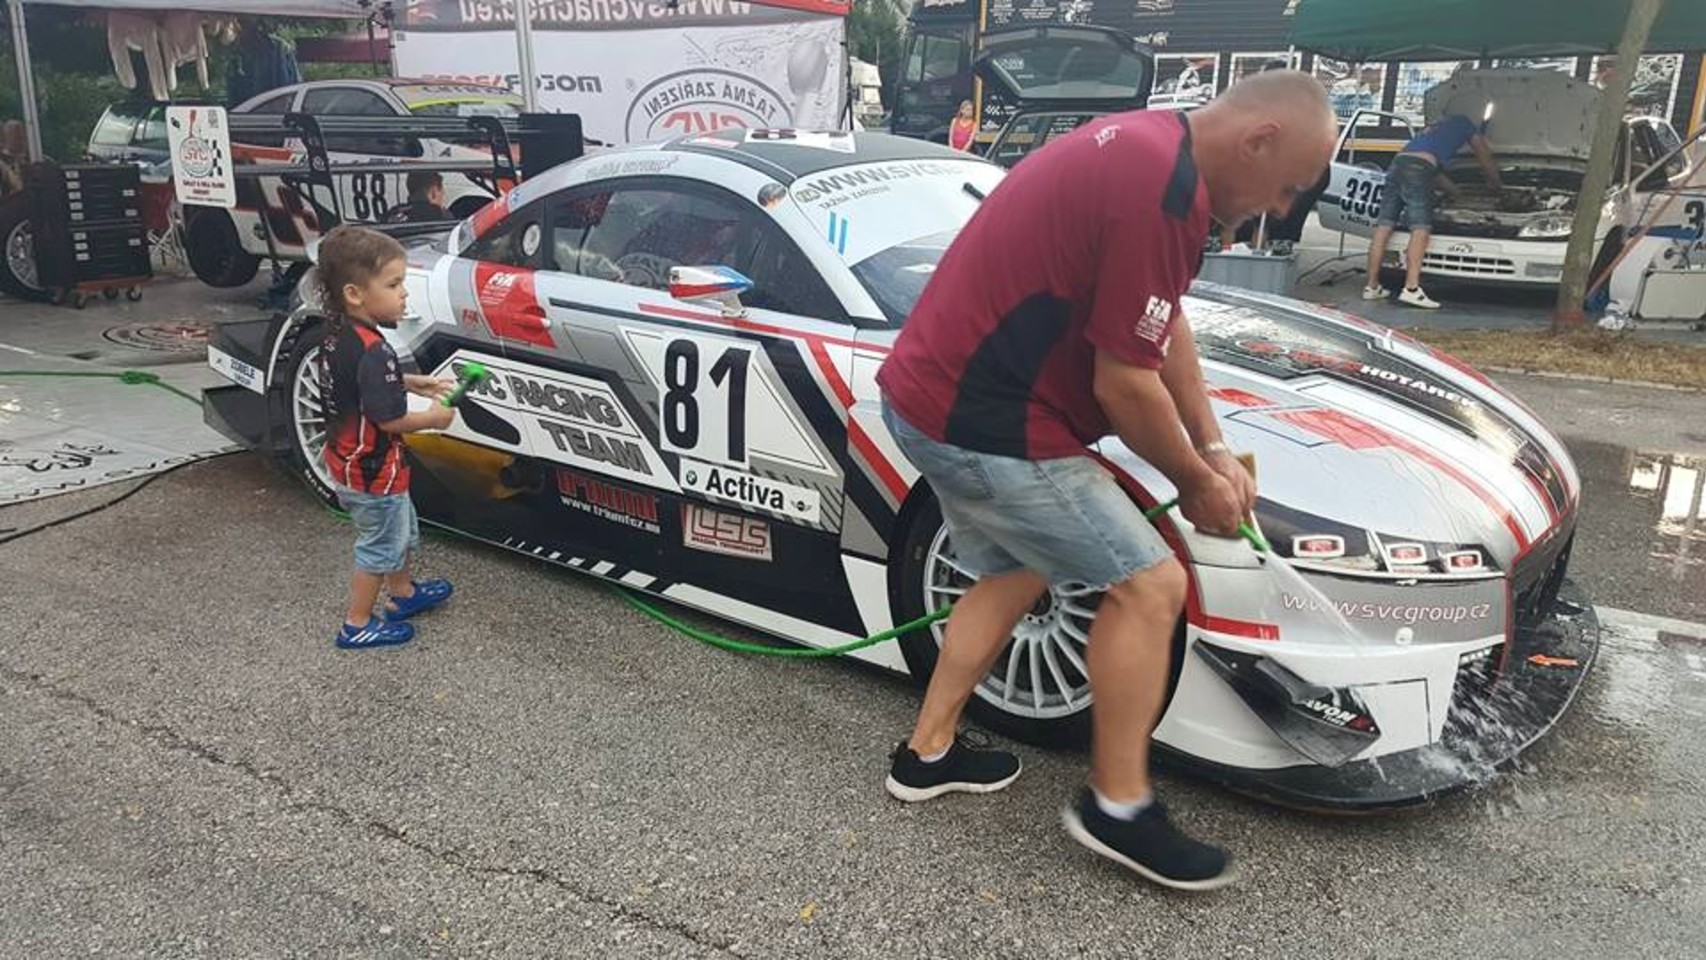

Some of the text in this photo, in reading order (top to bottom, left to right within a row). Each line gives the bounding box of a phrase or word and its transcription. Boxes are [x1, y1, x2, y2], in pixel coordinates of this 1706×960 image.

[351, 171, 389, 221] 88
[506, 375, 623, 428] RACING
[665, 339, 751, 463] 81
[538, 419, 653, 475] TEAM
[705, 468, 785, 510] Activa
